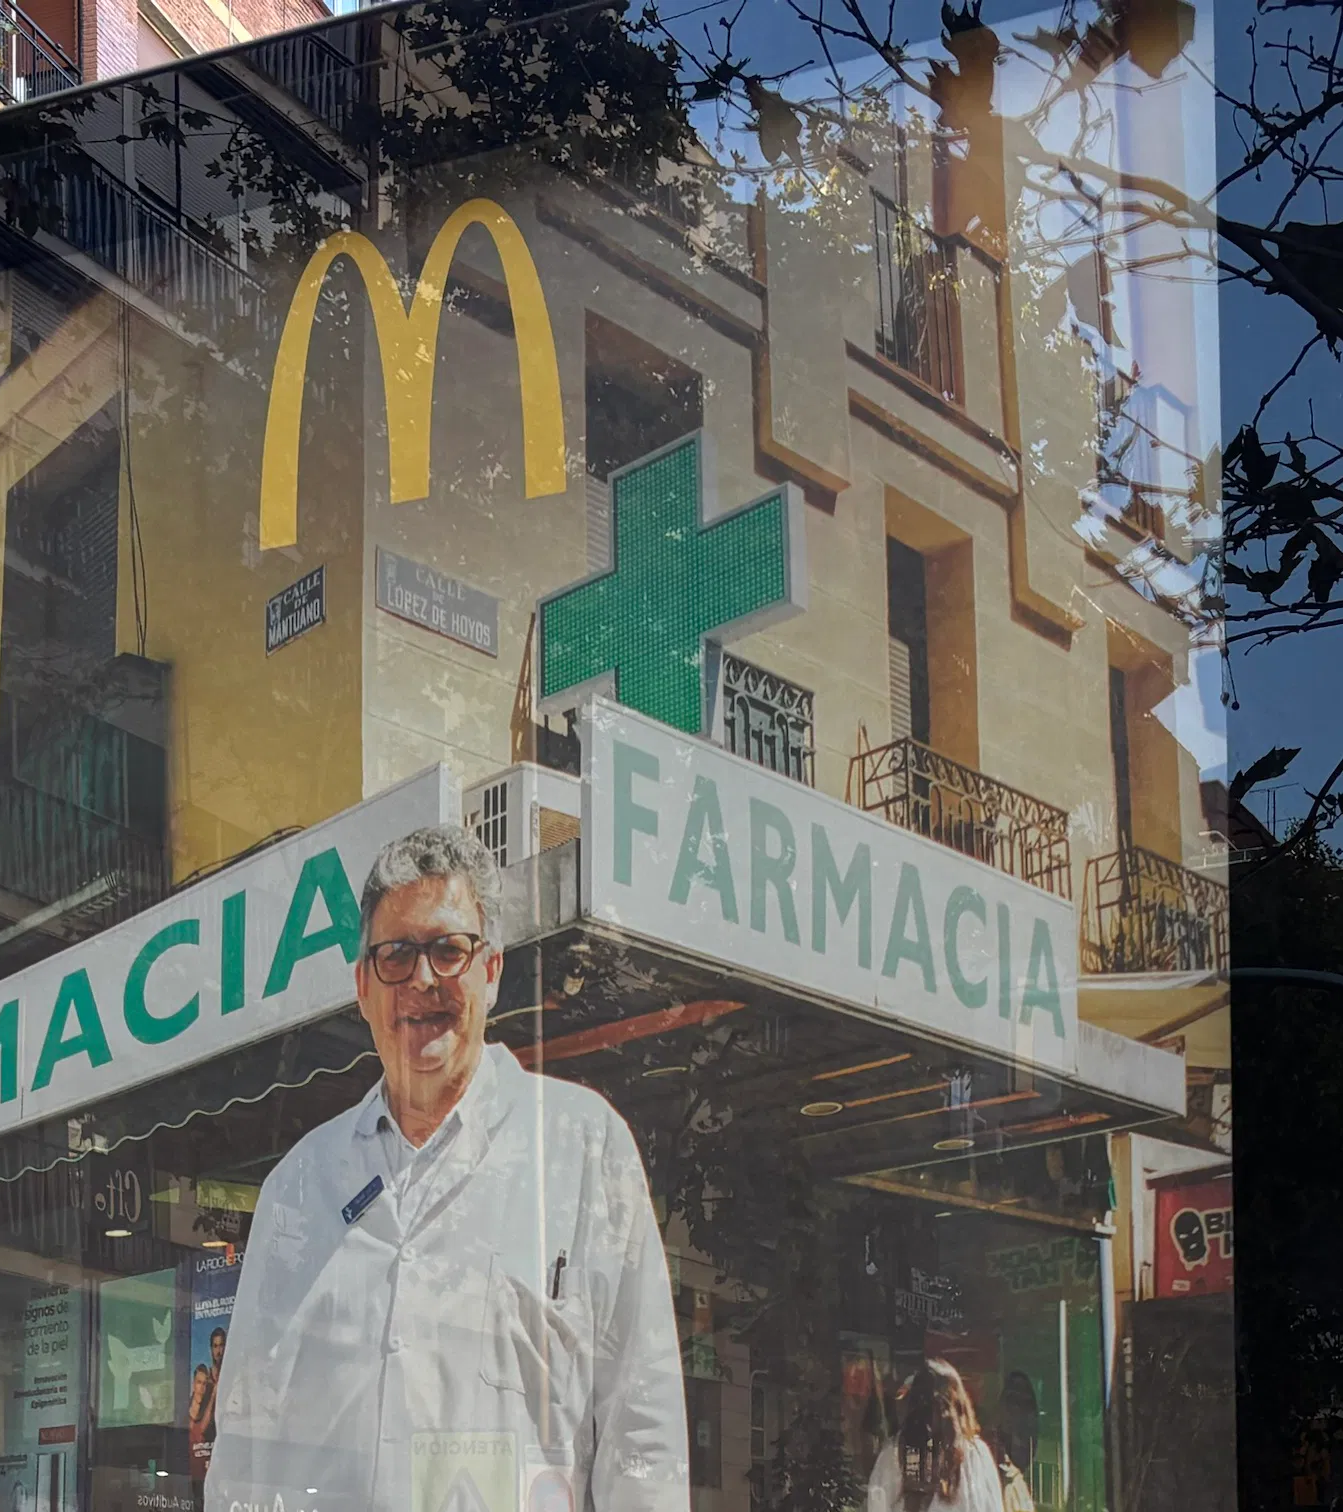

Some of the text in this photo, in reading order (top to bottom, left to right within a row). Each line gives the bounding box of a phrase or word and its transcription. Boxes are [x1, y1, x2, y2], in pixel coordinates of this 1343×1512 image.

[283, 571, 320, 604] CALLE
[416, 567, 466, 601] CALLE
[268, 598, 320, 648] MANTUANO
[432, 606, 447, 630] DE
[451, 614, 491, 647] HOYOS
[613, 740, 1065, 1039] FARMACIA
